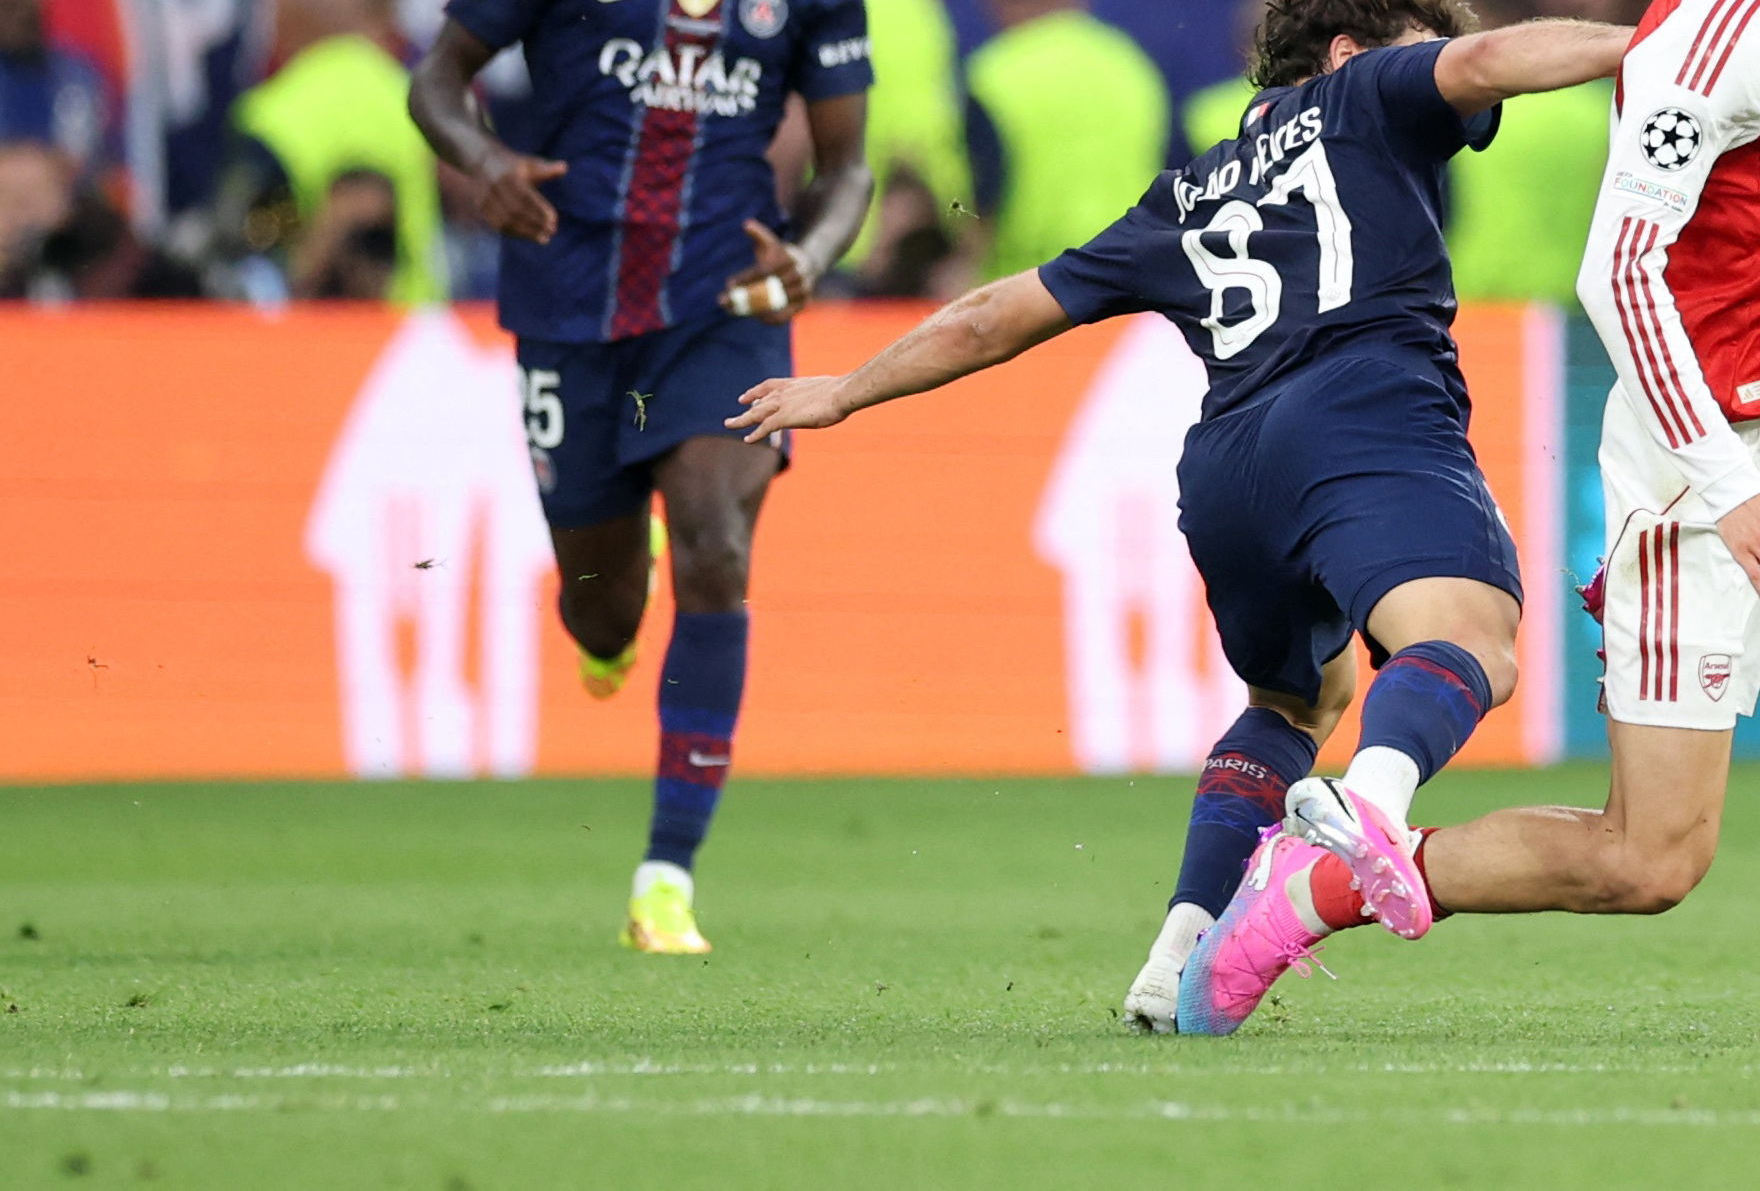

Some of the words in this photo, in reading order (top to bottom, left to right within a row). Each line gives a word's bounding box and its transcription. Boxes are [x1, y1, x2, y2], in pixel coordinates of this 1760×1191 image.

[599, 37, 762, 96] QATAR
[1614, 176, 1688, 207] FOUNDATION
[1181, 137, 1353, 360] 87
[516, 365, 564, 449] 5
[1704, 661, 1730, 670] Arsenal
[1201, 757, 1268, 779] PARIS
